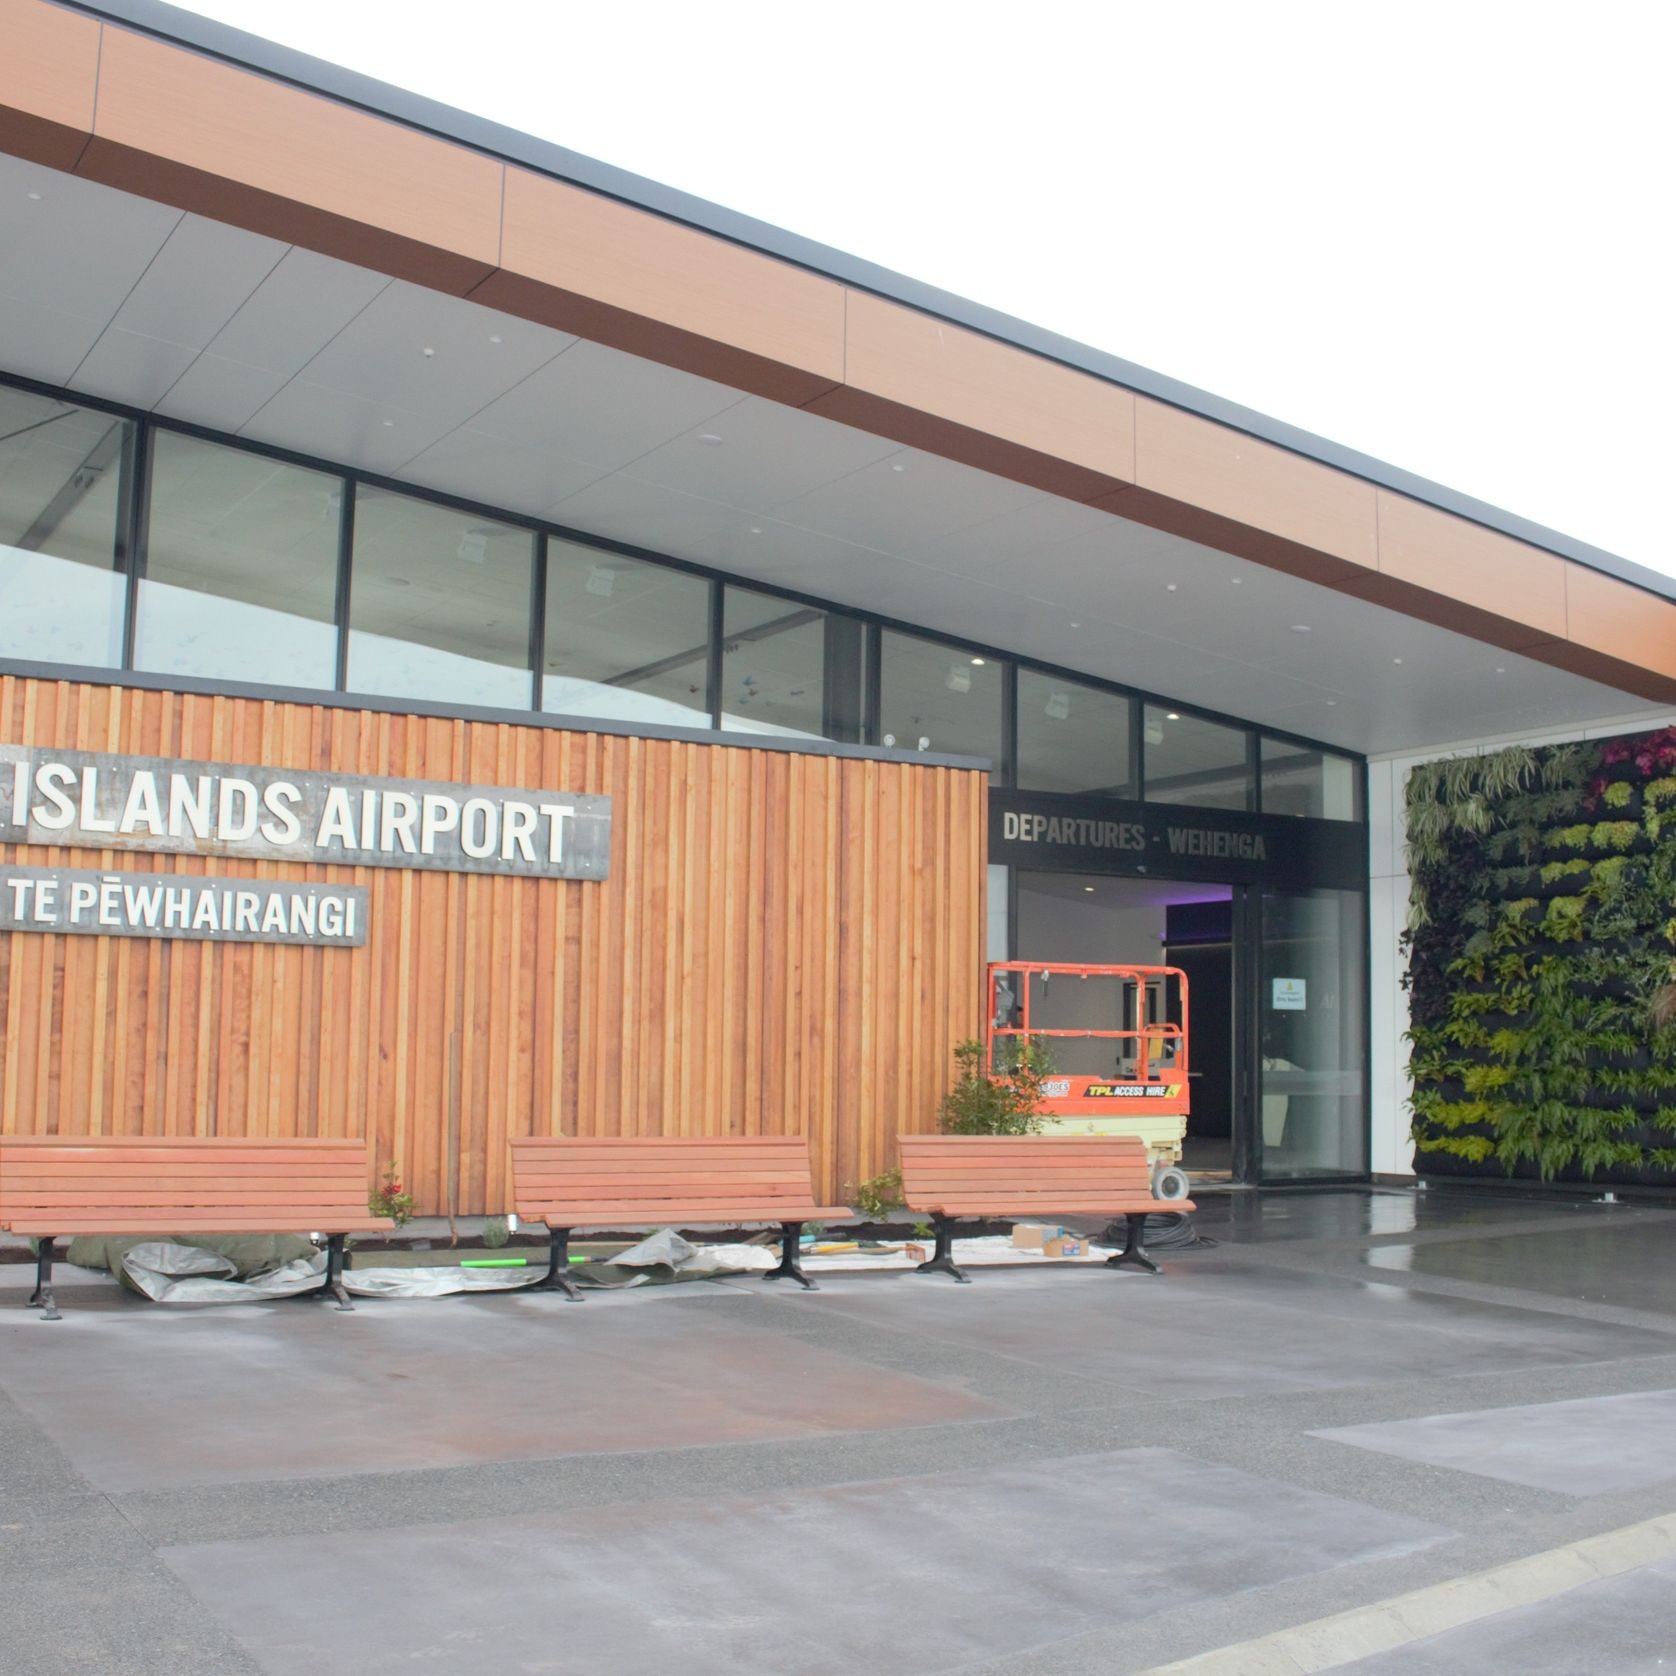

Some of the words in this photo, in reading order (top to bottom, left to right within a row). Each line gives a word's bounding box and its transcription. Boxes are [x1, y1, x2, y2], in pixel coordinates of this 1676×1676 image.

[11, 761, 302, 846] ISLANDS
[315, 786, 575, 864] AIRPORT
[1003, 811, 1146, 851] DEPARTURES
[1167, 827, 1267, 861] WEHENGA
[7, 878, 57, 922] TE
[69, 876, 356, 937] PĒWHAIRANGI
[1088, 1086, 1114, 1096] TPL
[1114, 1086, 1144, 1097] ACCESS
[1146, 1086, 1166, 1097] HIRE
